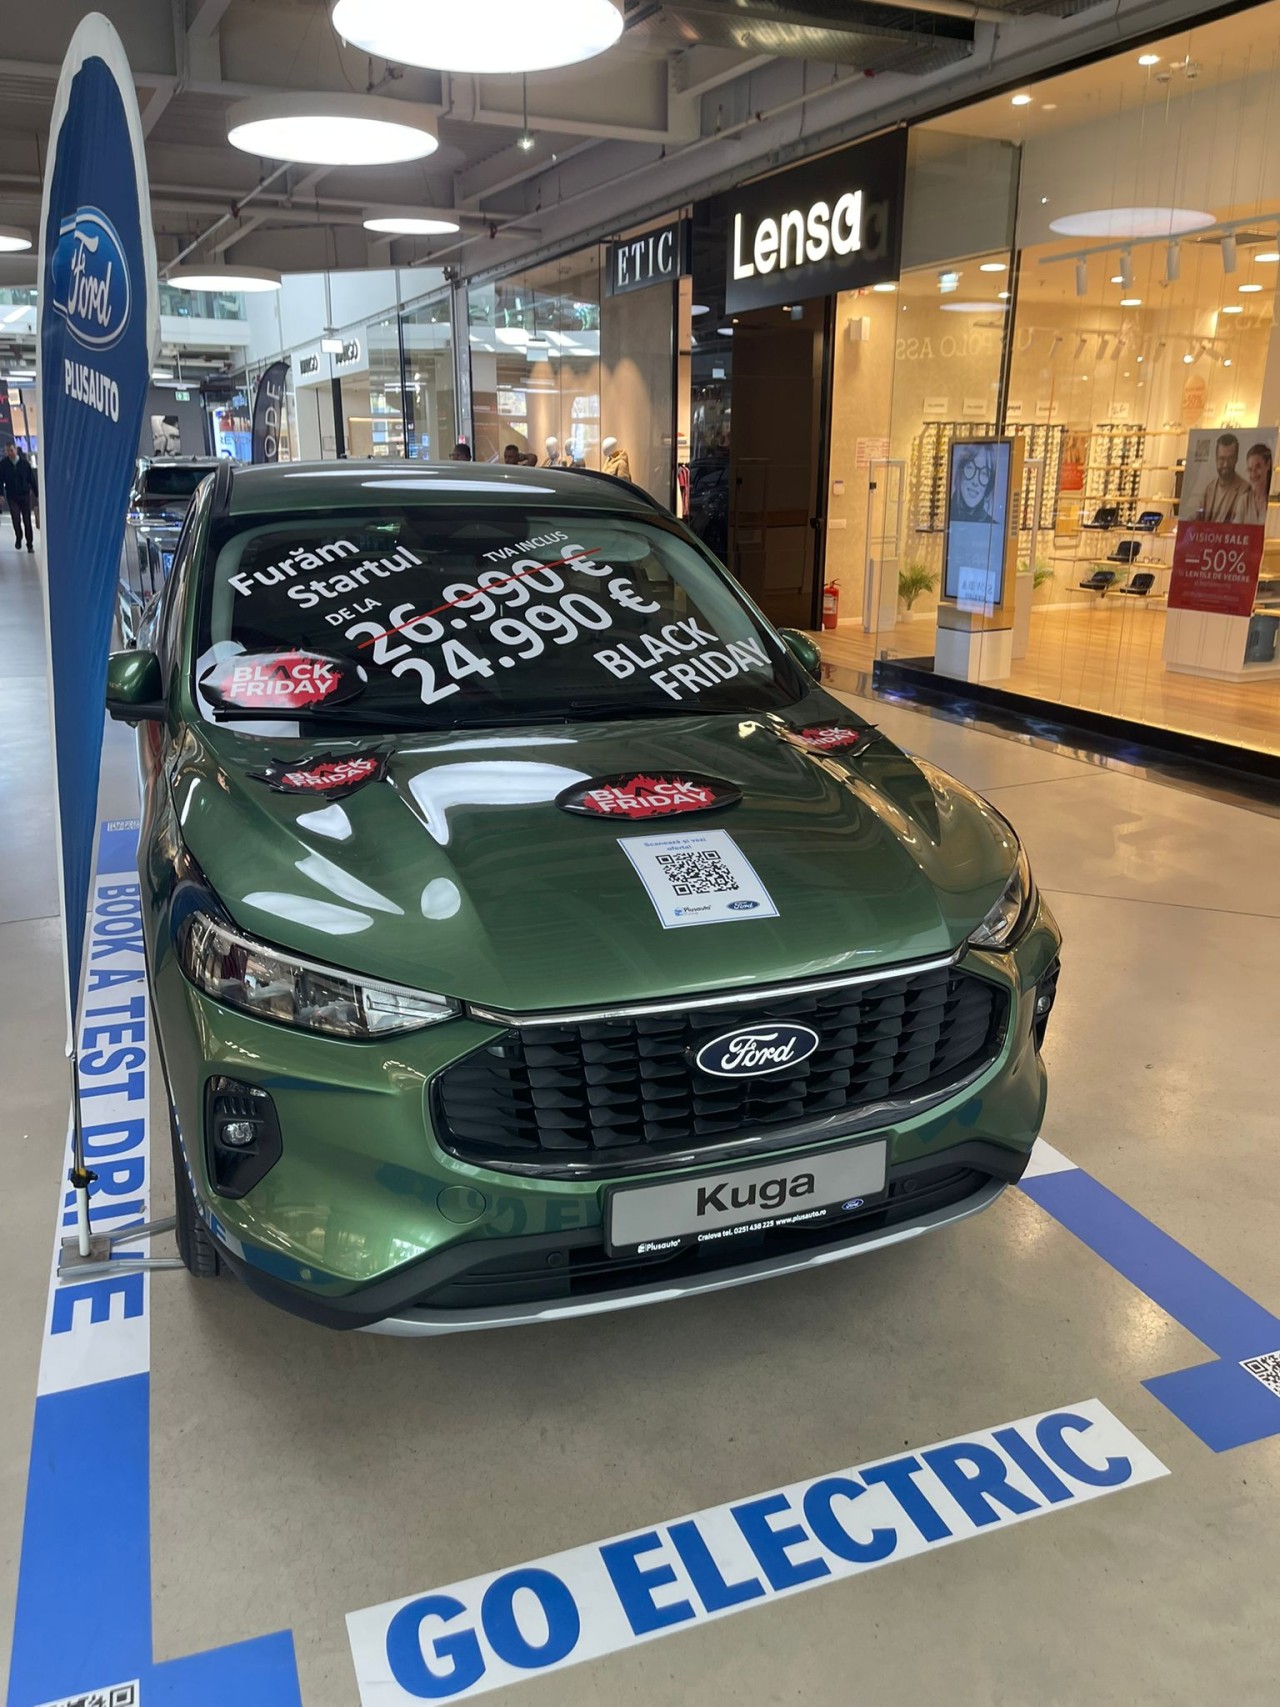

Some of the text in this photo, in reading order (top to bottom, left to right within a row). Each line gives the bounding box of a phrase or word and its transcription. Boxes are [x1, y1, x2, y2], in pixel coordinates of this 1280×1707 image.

[617, 230, 673, 287] ETIC
[733, 189, 862, 280] Lensa
[68, 230, 112, 328] Ford
[64, 358, 119, 422] PLUSAUTO
[482, 530, 568, 563] TVA INCLUS
[1189, 532, 1249, 545] VISION SALE
[228, 540, 360, 597] Furăm
[287, 546, 422, 609] Startul
[325, 597, 382, 627] DE LA
[345, 544, 613, 665] 26.990 €
[392, 578, 661, 705] 24.990 €
[593, 617, 719, 679] BLACK
[230, 679, 333, 697] FRIDAY
[233, 663, 334, 682] BLACK
[650, 637, 772, 700] FRIDAY
[284, 758, 364, 781] BLACK
[292, 762, 372, 786] FRIDAY
[587, 781, 702, 801] BLACK
[598, 791, 708, 812] FRIDAY
[93, 883, 145, 961] BOOK
[87, 969, 146, 992] A
[78, 995, 146, 1102] TEST
[721, 1032, 797, 1070] Ford
[696, 1172, 815, 1217] Kuga
[722, 1228, 732, 1237] tel.
[775, 1208, 827, 1225] www.plusauto.ro
[386, 1412, 1132, 1699] GO ELECTRIC
